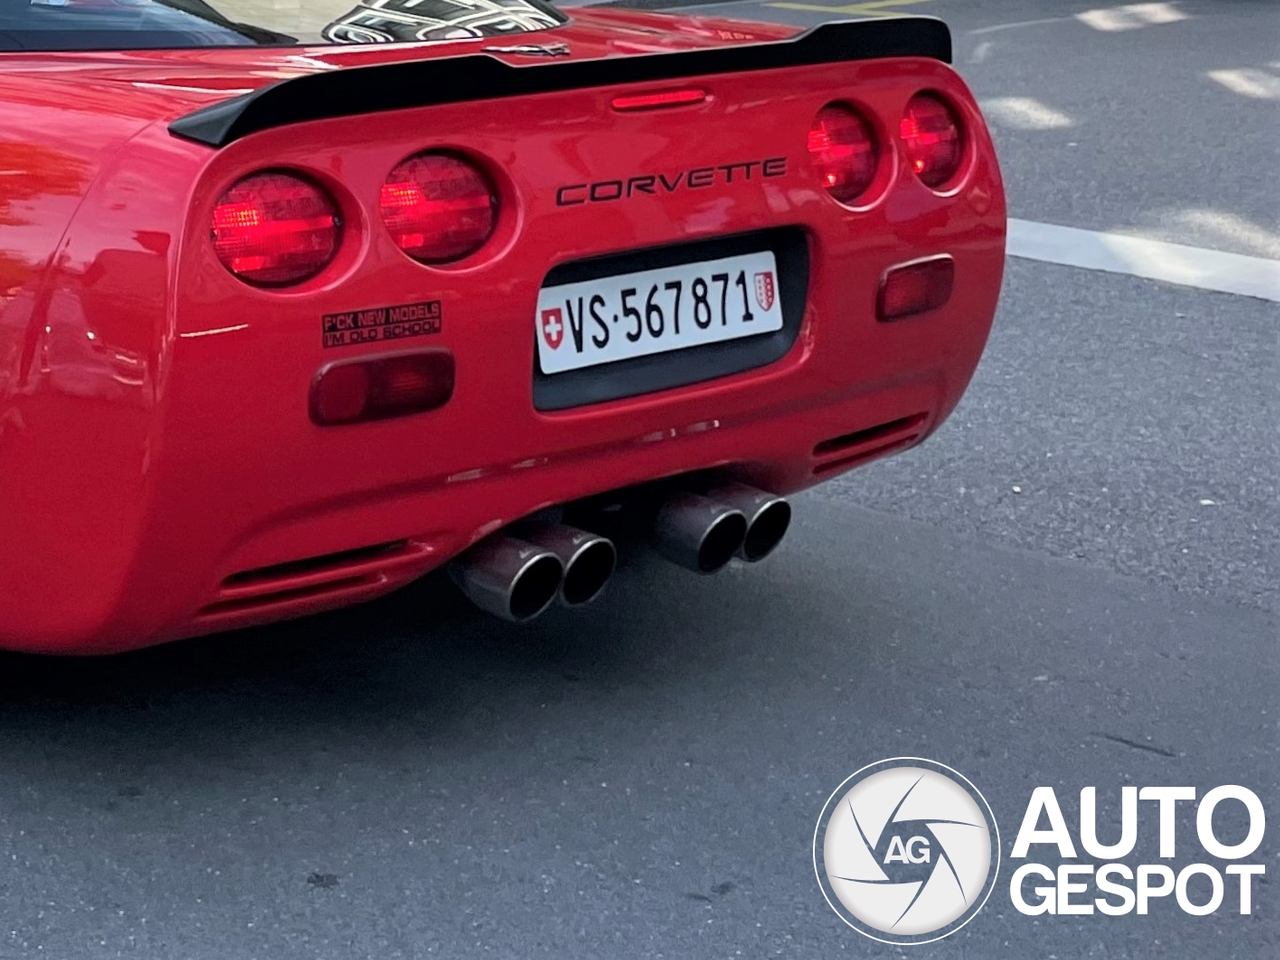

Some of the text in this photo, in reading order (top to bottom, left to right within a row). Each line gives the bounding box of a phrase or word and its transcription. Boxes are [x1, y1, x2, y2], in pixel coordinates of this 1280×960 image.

[555, 157, 787, 207] CORVETTE
[357, 309, 387, 327] NEW
[389, 303, 439, 322] MODELS
[350, 327, 378, 344] OLD
[383, 320, 440, 338] SCHOOL
